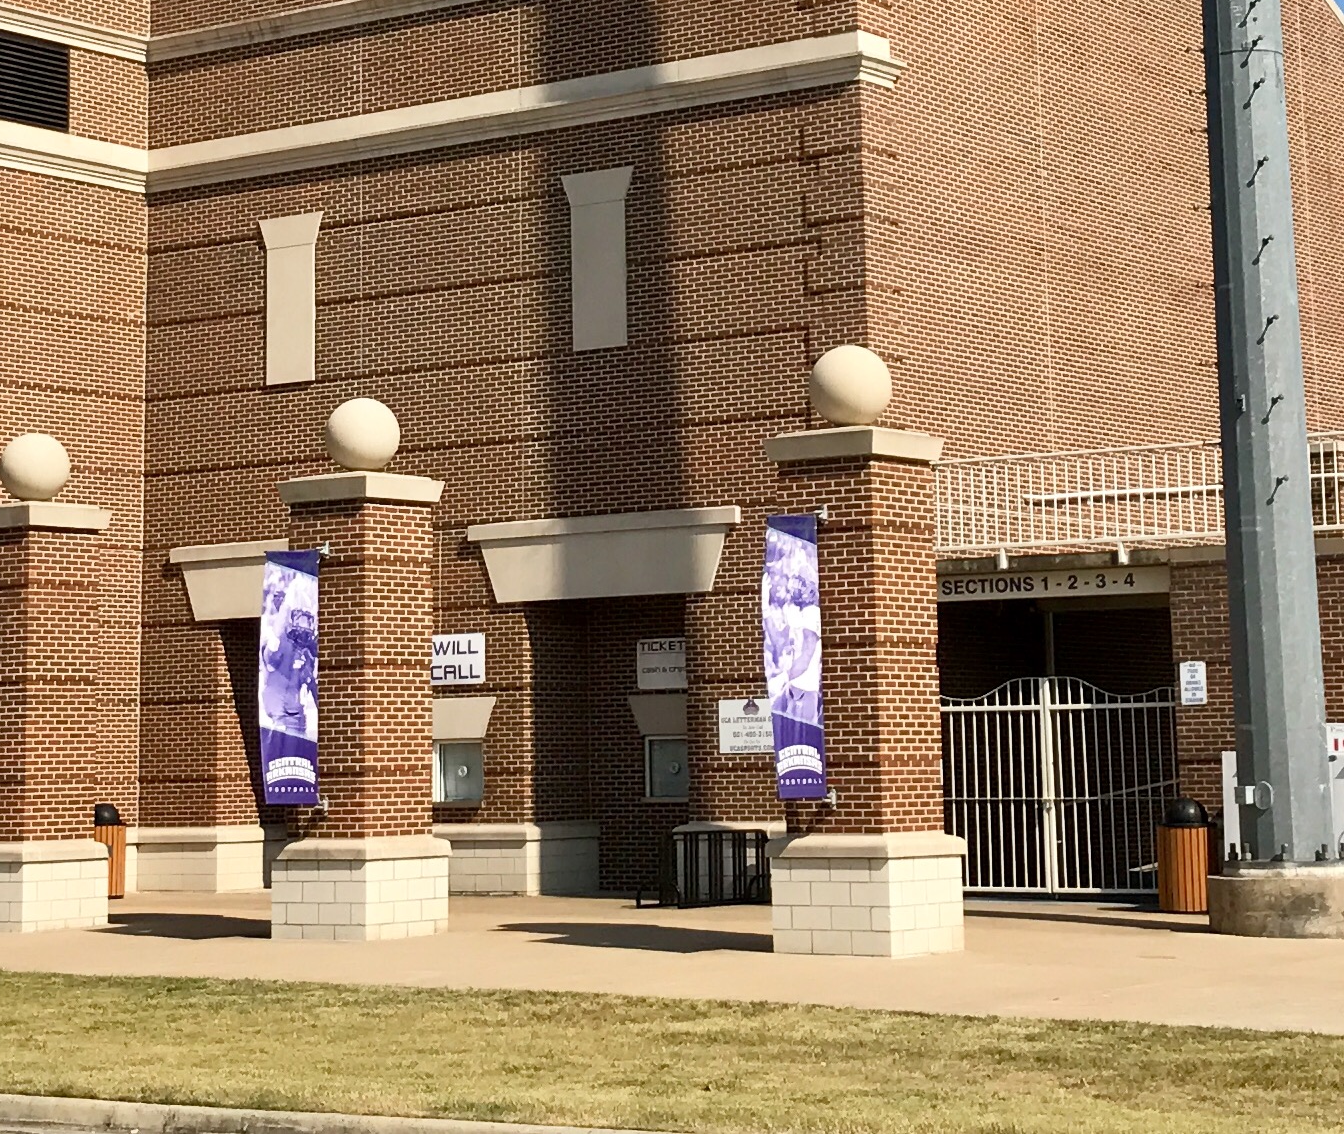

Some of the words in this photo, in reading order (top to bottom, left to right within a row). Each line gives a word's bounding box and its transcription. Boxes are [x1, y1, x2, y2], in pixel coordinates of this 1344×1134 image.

[941, 576, 1035, 596] SECTIONS
[432, 639, 479, 656] WILL
[431, 664, 481, 680] CALL
[778, 744, 821, 762] CENTRAL
[268, 756, 314, 771] CENTRAL
[777, 755, 823, 774] ARKANSAS
[266, 766, 316, 782] ARKANSAS
